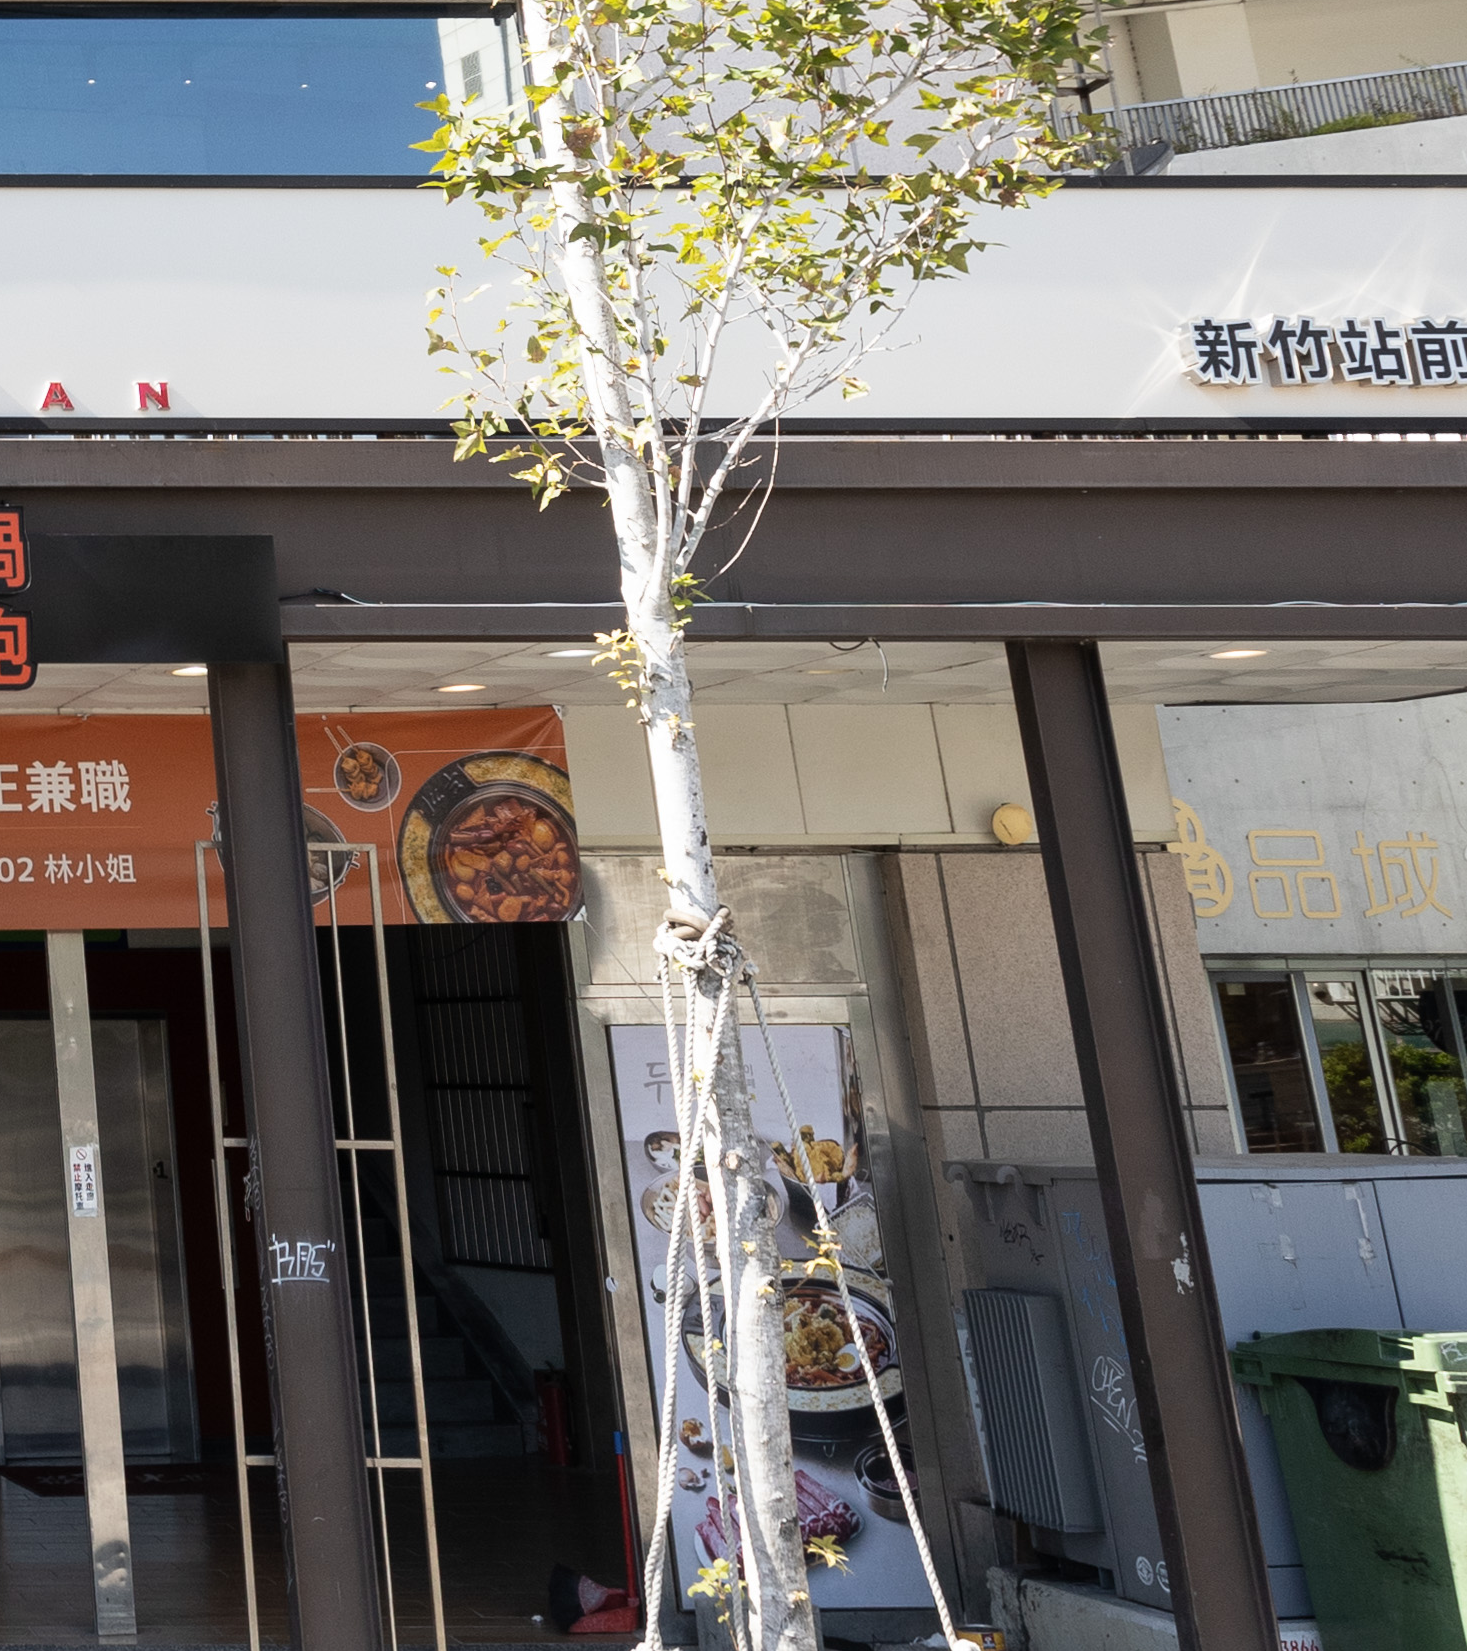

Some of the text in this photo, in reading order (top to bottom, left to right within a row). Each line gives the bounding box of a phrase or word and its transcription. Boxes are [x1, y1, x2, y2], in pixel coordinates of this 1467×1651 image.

[44, 852, 138, 886] 林小姐
[644, 1062, 672, 1104] 두
